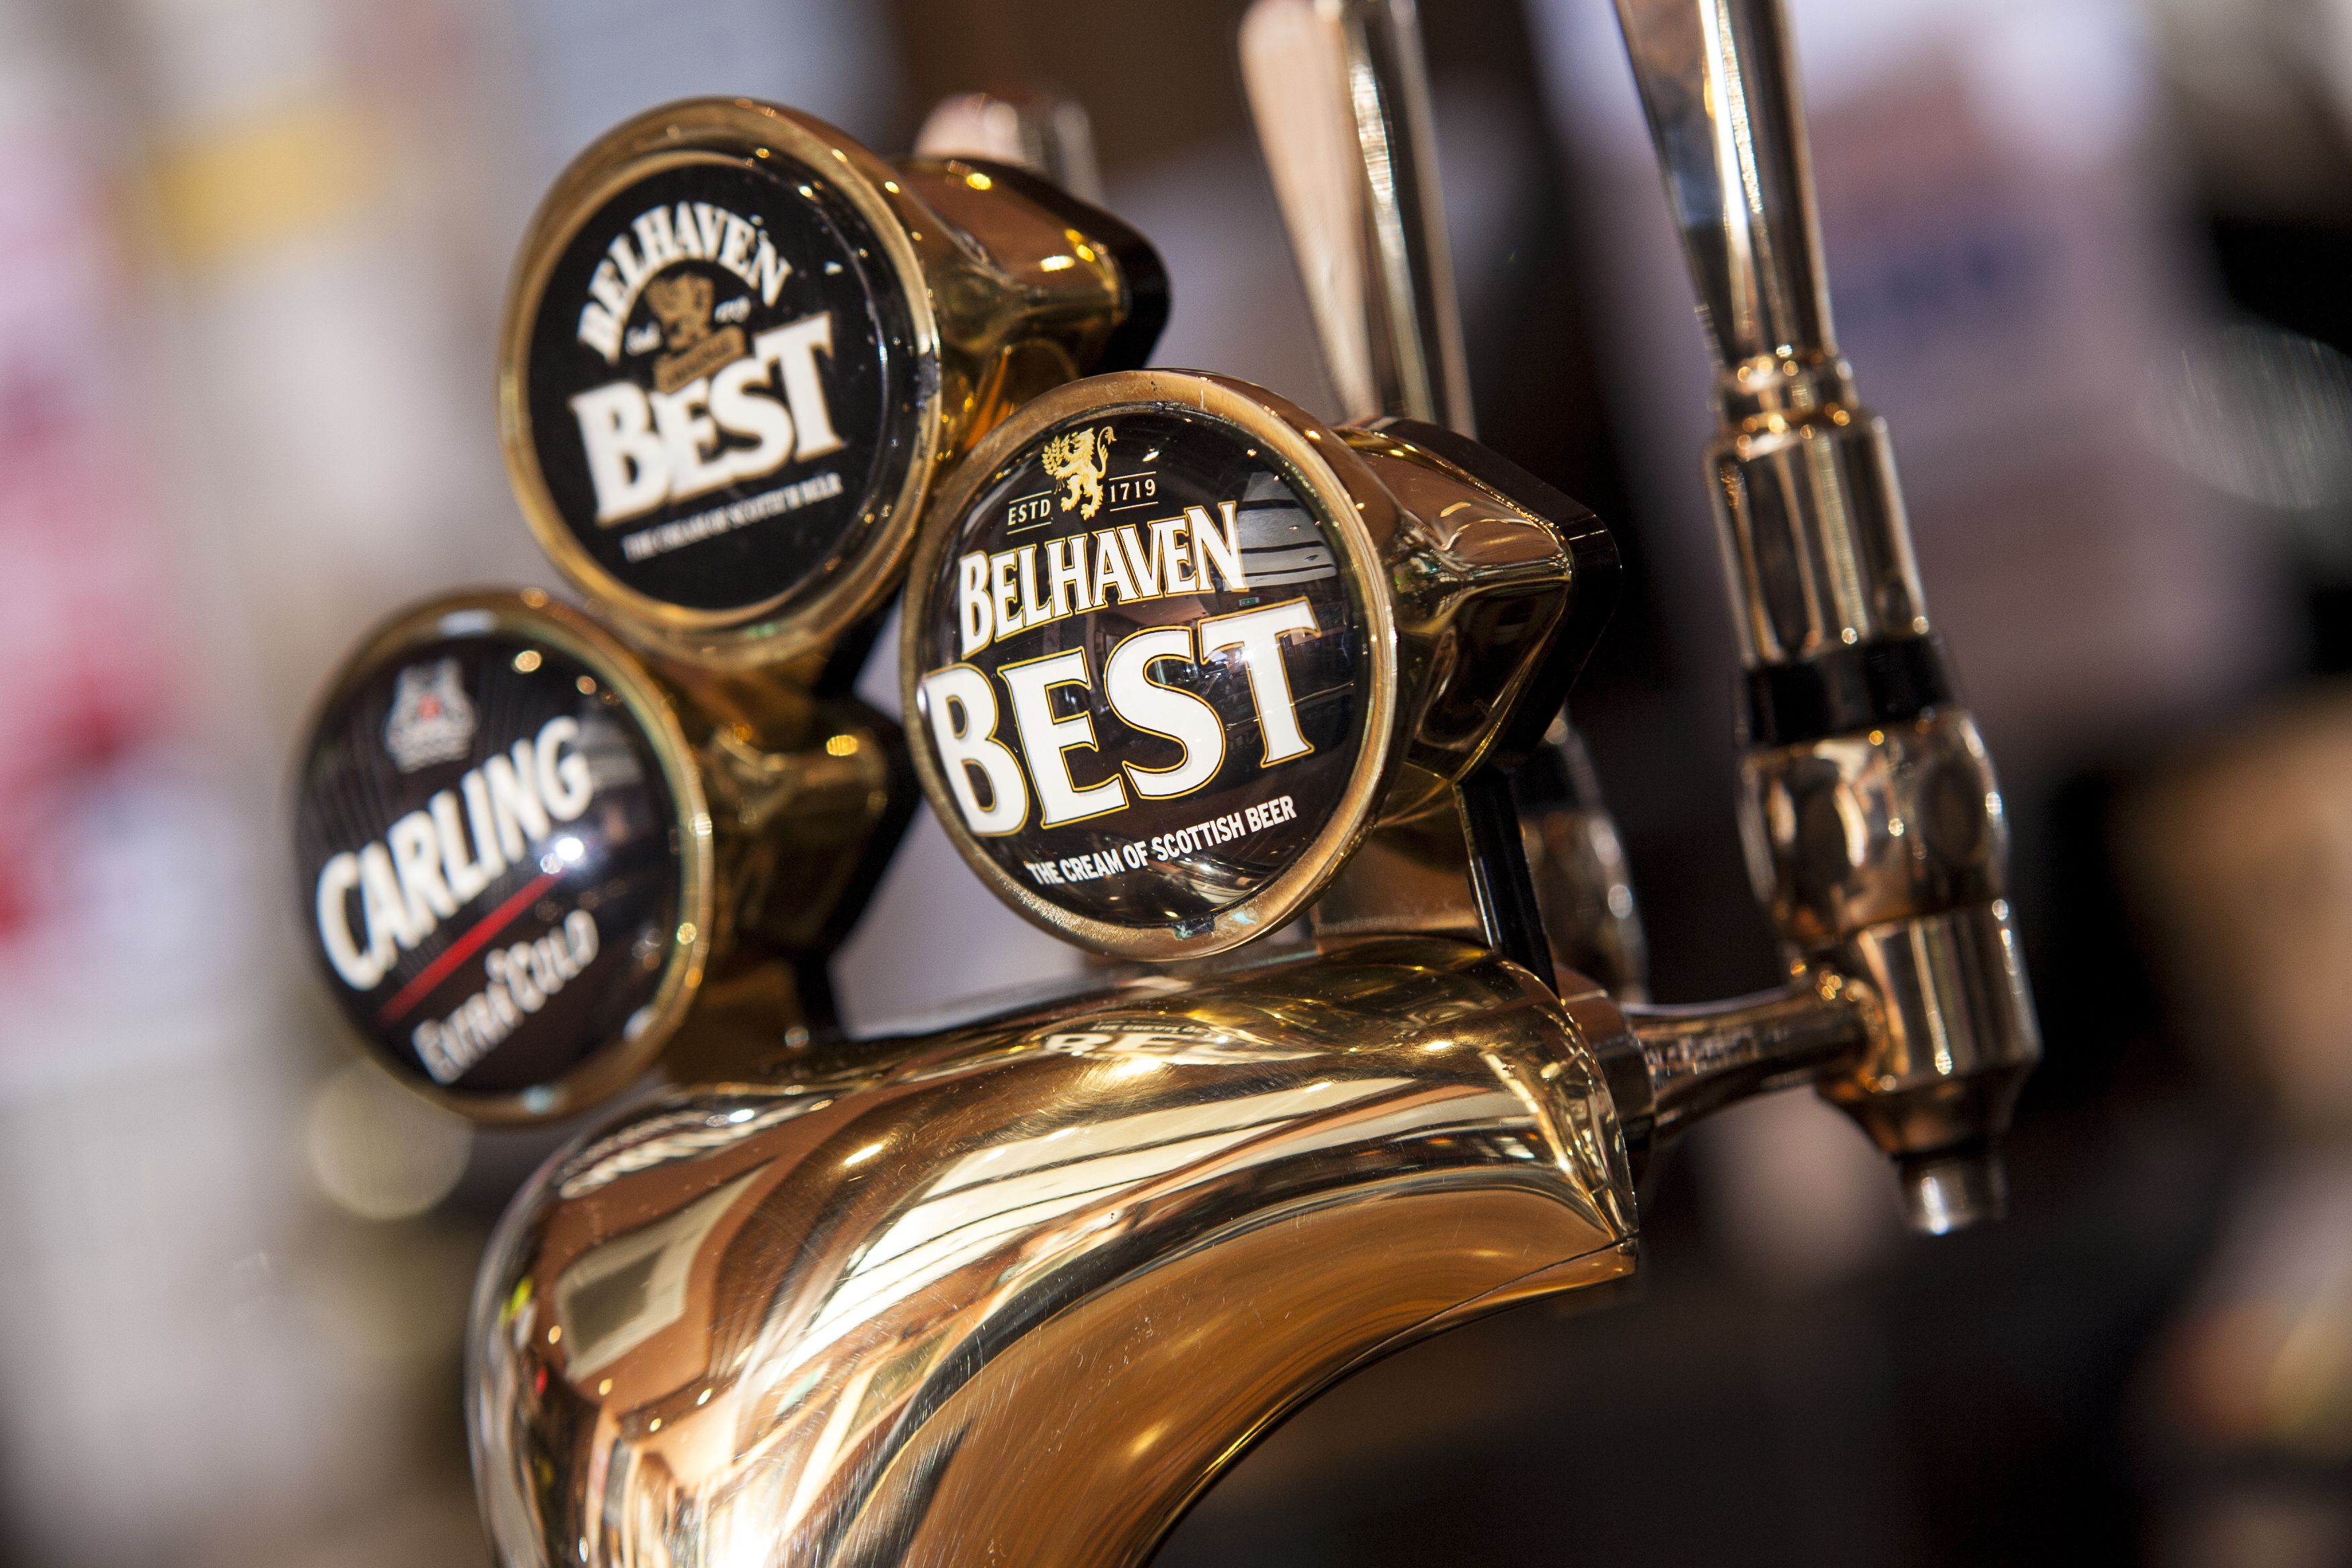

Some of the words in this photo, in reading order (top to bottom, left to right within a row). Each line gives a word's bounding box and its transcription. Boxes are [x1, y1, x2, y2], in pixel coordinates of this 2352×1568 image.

[577, 201, 793, 366] BELHAVEN
[568, 312, 847, 528] BEST
[1008, 499, 1050, 526] ESTD
[1110, 479, 1156, 503] 1719
[959, 500, 1249, 660] BELHAVEN
[920, 596, 1322, 836] BEST
[315, 716, 593, 991] CARLING
[1025, 861, 1065, 885] THE
[1059, 848, 1125, 883] CREAM
[1122, 841, 1148, 870] OF
[1150, 811, 1246, 861] SCOTTISH
[1247, 795, 1297, 833] BEER
